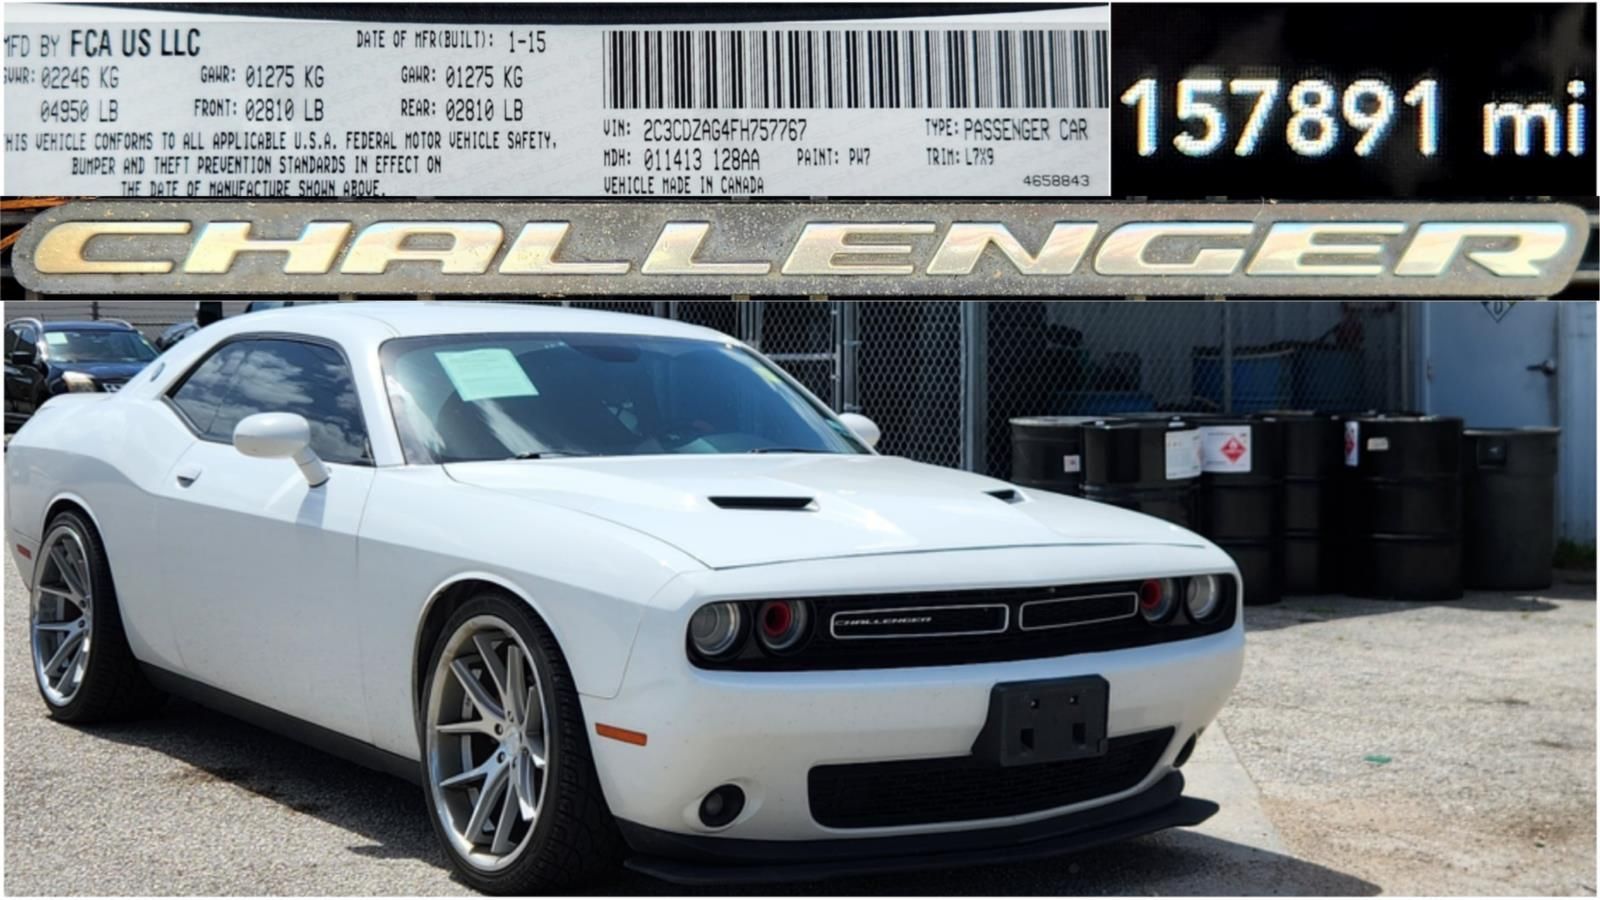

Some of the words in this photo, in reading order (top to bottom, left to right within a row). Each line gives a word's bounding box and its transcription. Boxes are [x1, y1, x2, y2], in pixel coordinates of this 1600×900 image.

[40, 35, 59, 57] BY
[71, 29, 112, 58] FCA
[122, 28, 151, 57] US
[161, 28, 200, 57] LLC
[357, 30, 385, 48] DATE
[393, 30, 407, 48] OF
[415, 30, 493, 48] MFR(BUILT):
[509, 30, 546, 53] 1-15
[41, 66, 89, 89] 02246
[100, 66, 118, 88] KG
[201, 65, 235, 83] GAWR:
[246, 65, 294, 88] 01275
[305, 65, 324, 88] KG
[401, 65, 435, 83] GAWR:
[446, 65, 494, 88] 01275
[504, 65, 523, 88] KG
[41, 100, 88, 123] 04950
[99, 99, 118, 122] LB
[194, 98, 236, 116] FRONT:
[245, 98, 294, 122] 02810
[304, 98, 324, 121] LB
[401, 98, 435, 116] REAR:
[446, 98, 494, 121] 02810
[504, 98, 523, 121] LB
[1121, 78, 1438, 157] 157891
[1482, 79, 1587, 157] mi
[6, 133, 27, 151] HIS
[36, 133, 86, 151] VEHICLE
[95, 132, 153, 150] CONFORMS
[162, 132, 175, 150] TO
[183, 133, 204, 150] ALL
[213, 131, 286, 150] APPLICABLE
[294, 131, 336, 150] U.S.A.
[346, 131, 397, 150] FEDERAL
[405, 131, 441, 149] MOTOR
[449, 131, 499, 149] VEHICLE
[604, 119, 630, 137] VIN:
[644, 118, 807, 142] 2C3CDZAG4FH757767
[925, 118, 958, 136] TYPE:
[964, 118, 1050, 141] PASSENGER
[1060, 118, 1088, 141] CAR
[72, 157, 115, 175] BUMPER
[123, 156, 145, 175] AND
[154, 156, 189, 174] THEFT
[197, 156, 271, 174] PREVENTION
[280, 155, 345, 174] STANDARDS
[355, 155, 367, 174] IN
[376, 155, 419, 174] EFFECT
[427, 156, 441, 173] ON
[604, 148, 631, 167] MDH:
[644, 148, 702, 171] 011413
[714, 148, 760, 171] 128AA
[797, 148, 838, 166] PAINT:
[849, 148, 870, 165] PW7
[926, 147, 960, 165] TRIM:
[966, 147, 994, 165] L7X9
[121, 181, 142, 196] THE
[149, 180, 179, 196] DATE
[186, 180, 201, 196] OF
[209, 180, 291, 196] MANUFACTURE
[298, 180, 336, 196] SHOWN
[343, 179, 386, 196] ABOVE.
[604, 176, 654, 194] VEHICLE
[662, 176, 691, 194] MADE
[701, 176, 713, 194] IN
[721, 176, 764, 194] CANADA
[1023, 175, 1089, 187] 4658843
[33, 221, 1568, 276] CHALLENGER
